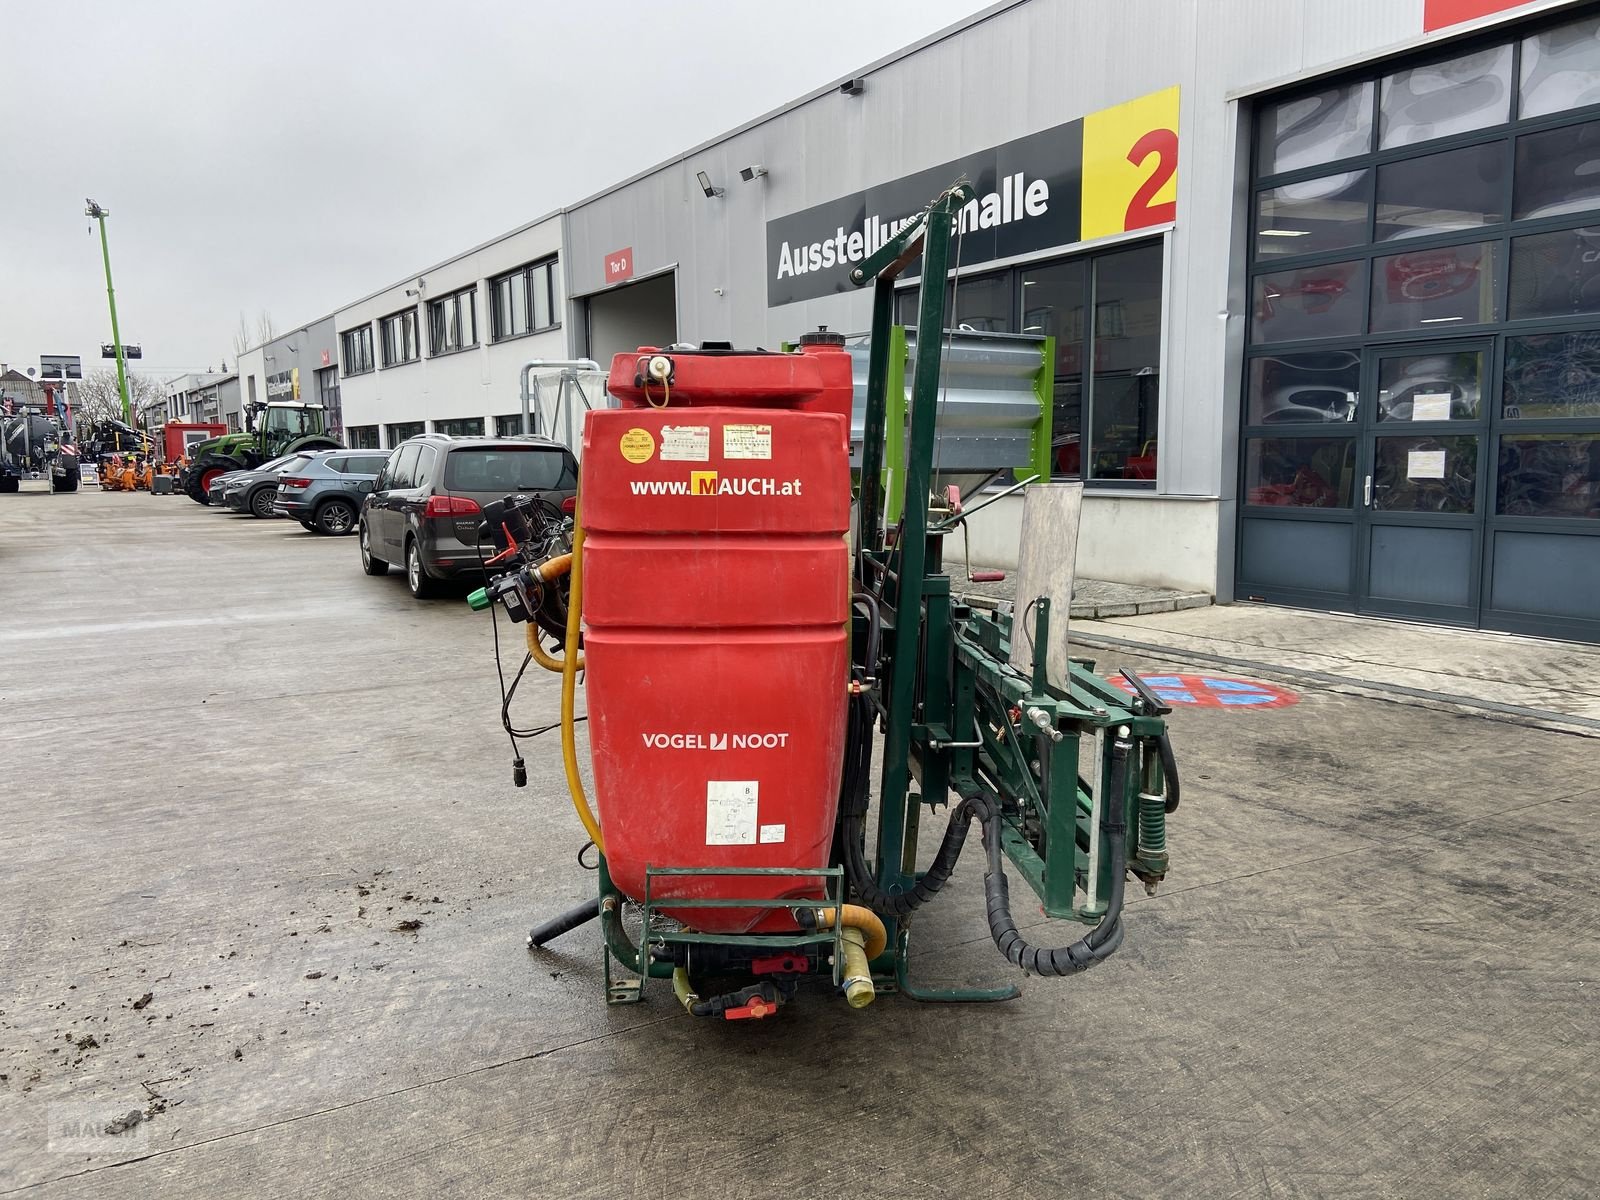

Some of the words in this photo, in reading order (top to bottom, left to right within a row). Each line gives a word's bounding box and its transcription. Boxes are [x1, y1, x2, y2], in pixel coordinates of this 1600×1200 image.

[1124, 128, 1178, 232] 2
[610, 261, 620, 274] Tor
[621, 258, 627, 271] D
[630, 477, 802, 496] www.MAUCH.at
[642, 733, 707, 749] VOGEL
[732, 733, 789, 749] NOOT
[745, 787, 750, 795] B
